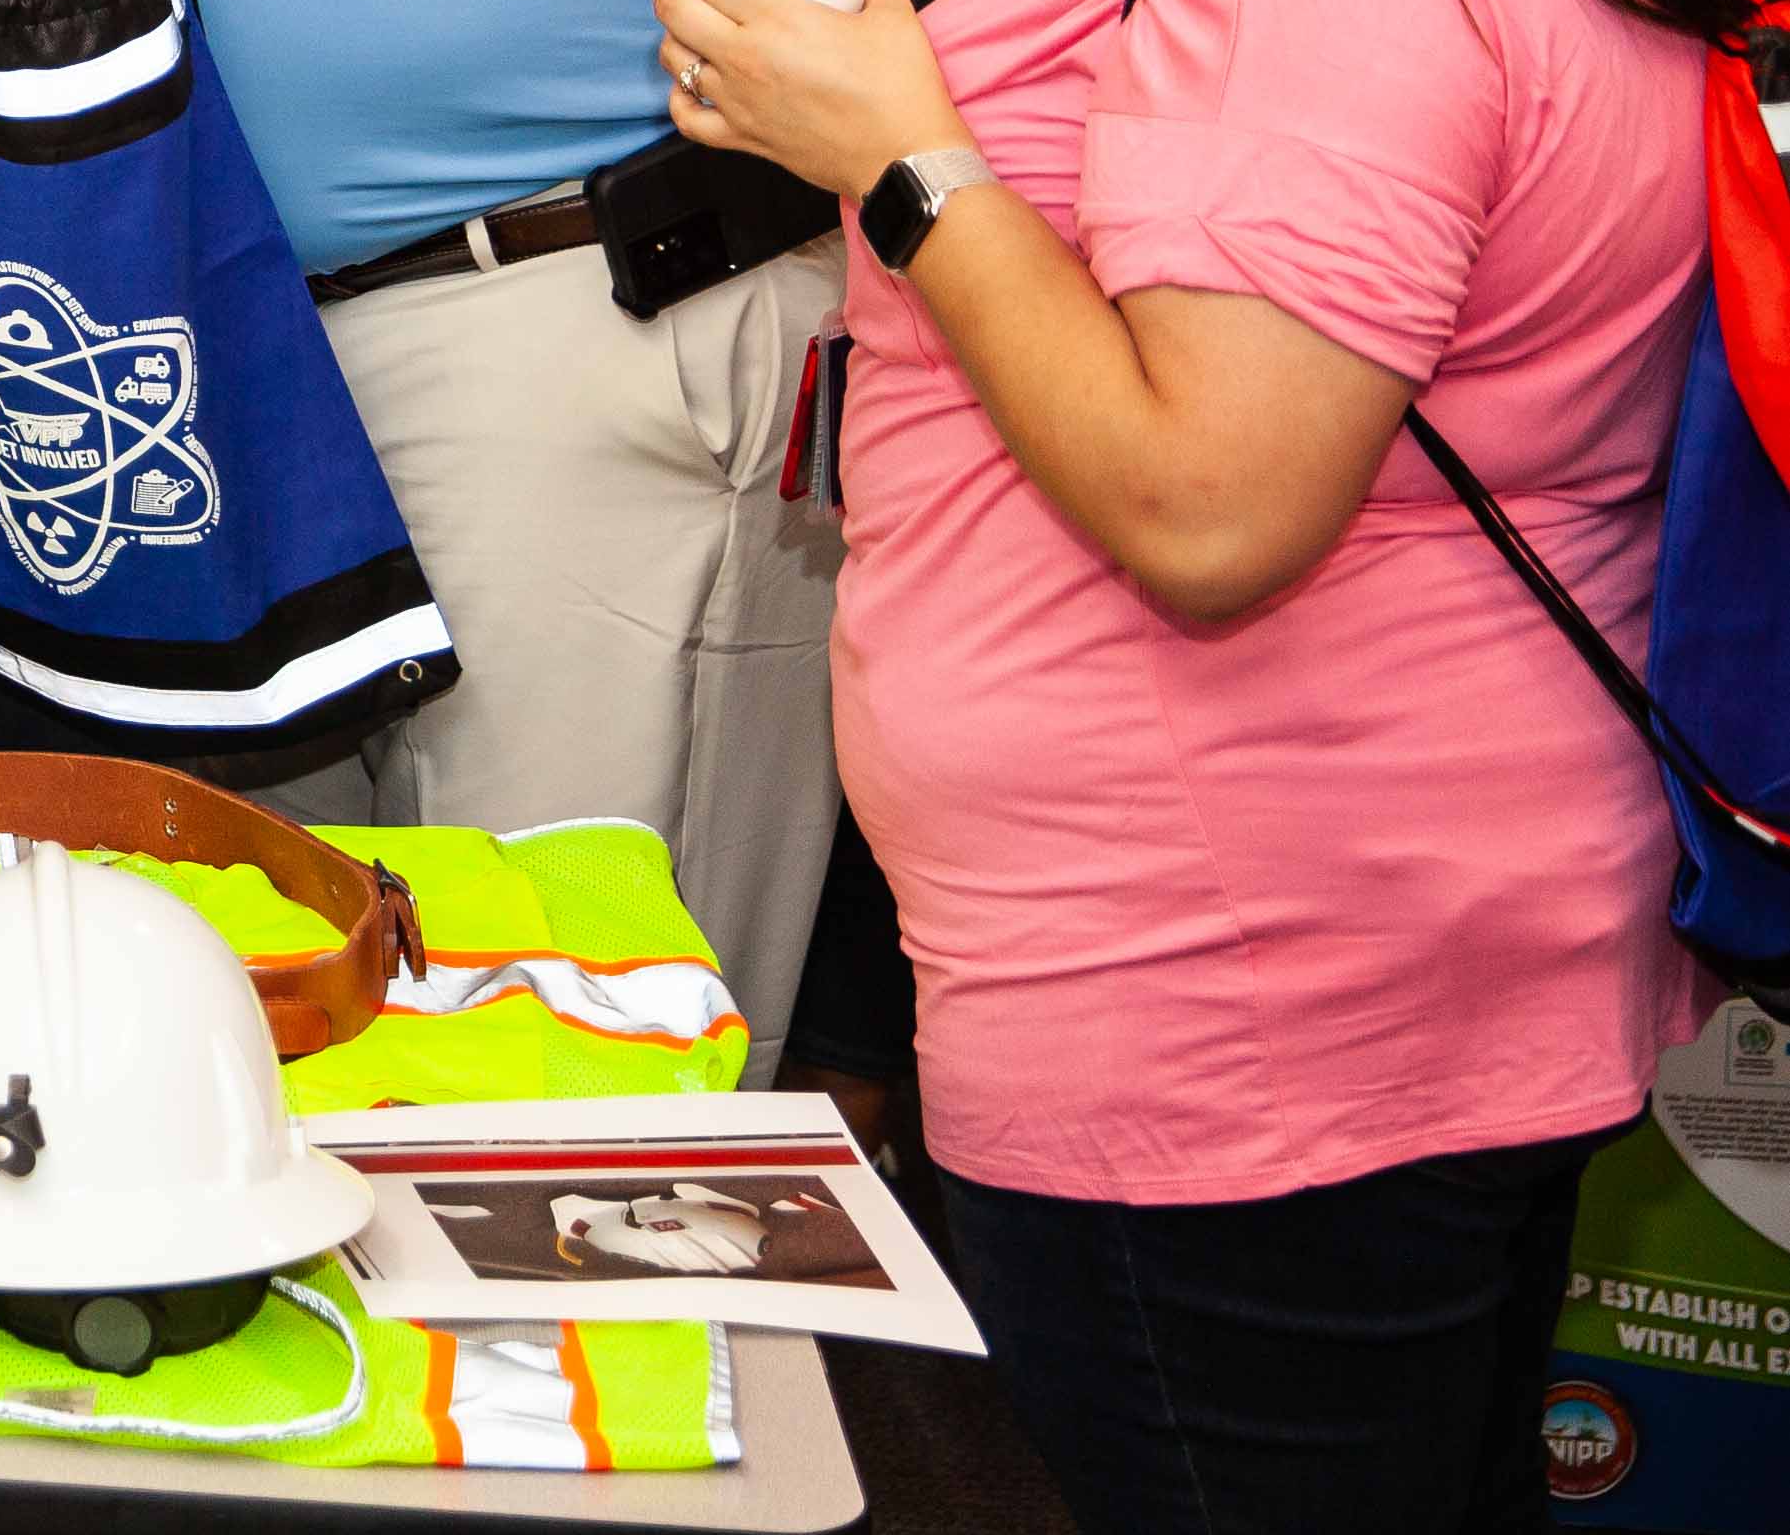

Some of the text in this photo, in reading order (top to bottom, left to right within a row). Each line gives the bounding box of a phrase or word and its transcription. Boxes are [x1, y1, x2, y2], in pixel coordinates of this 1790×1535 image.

[63, 296, 84, 317] SITE
[76, 313, 119, 338] SERVICES
[18, 422, 83, 448] VPP
[19, 444, 101, 470] INVOLVED
[14, 550, 45, 584] QUALITY
[1599, 1279, 1758, 1330] ESTABLISH
[1616, 1321, 1699, 1361] WITH
[1703, 1339, 1760, 1372] ALL
